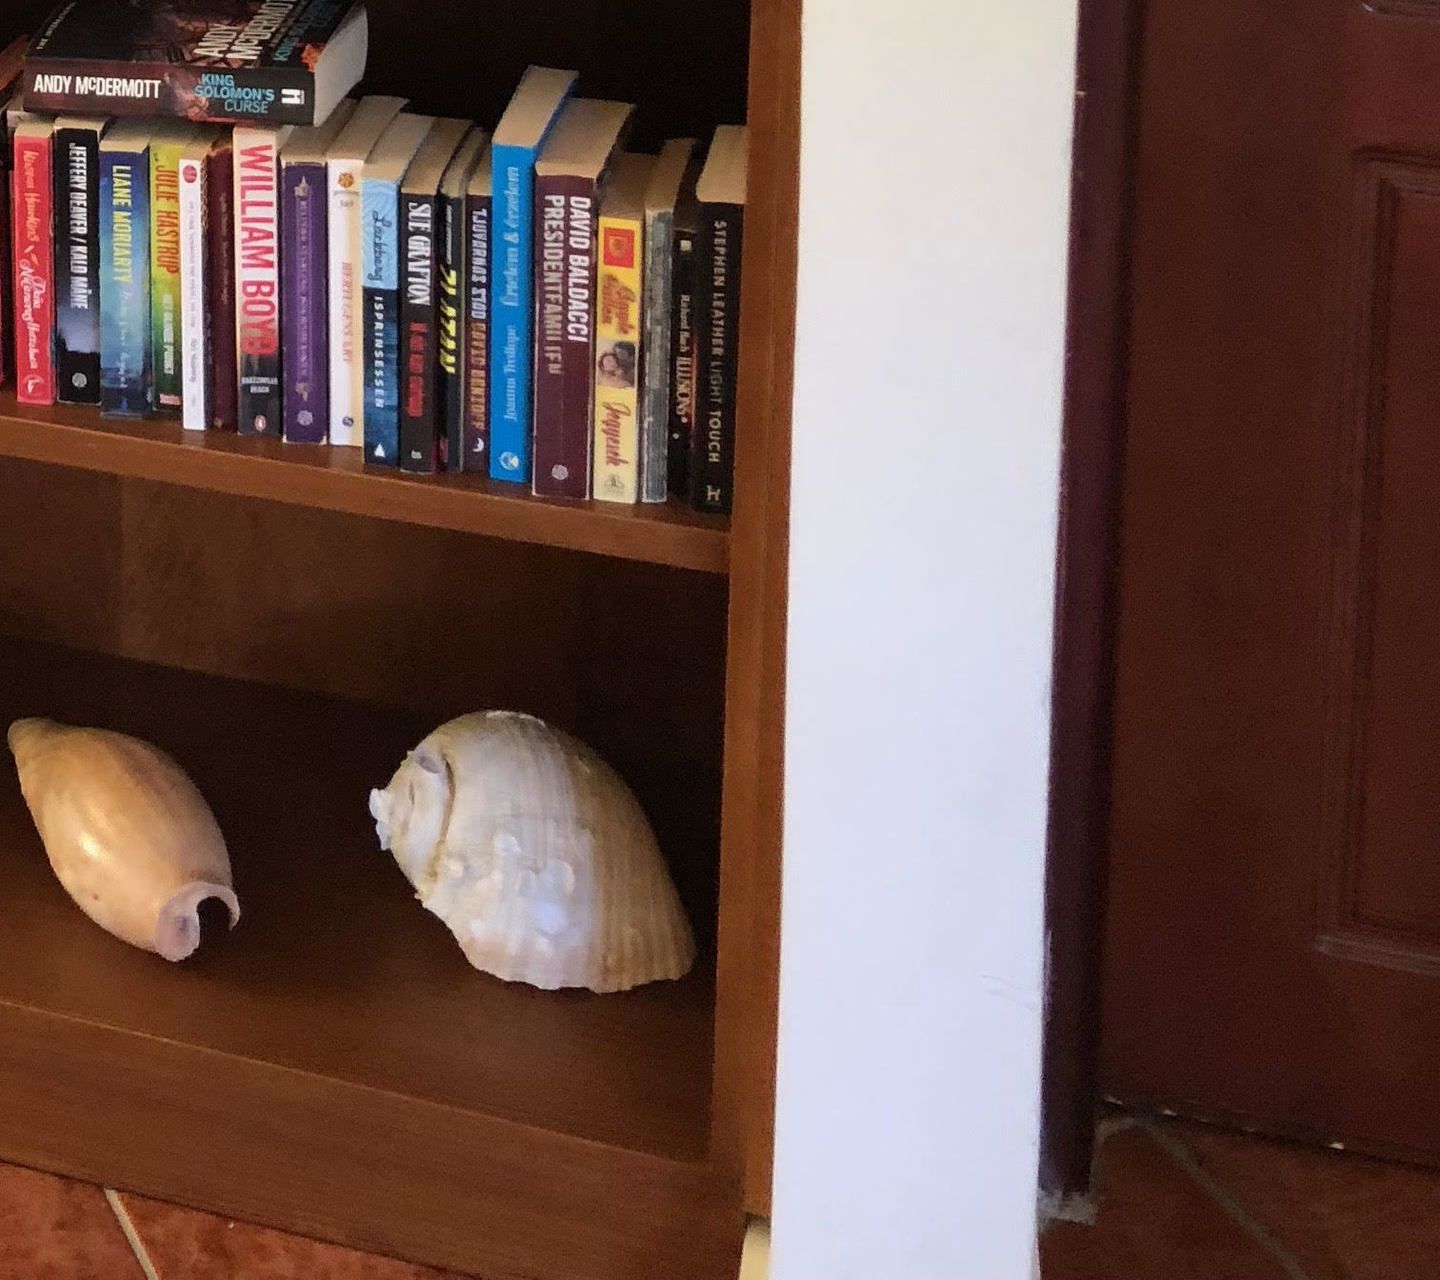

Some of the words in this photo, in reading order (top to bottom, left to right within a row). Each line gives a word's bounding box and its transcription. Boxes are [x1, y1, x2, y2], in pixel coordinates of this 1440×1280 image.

[192, 23, 237, 58] ANDY
[33, 74, 72, 94] ANDY
[75, 76, 161, 99] McDERMOTT
[194, 85, 275, 101] SOLOMON'S
[201, 73, 234, 86] KING
[224, 98, 269, 114] CURSE
[68, 143, 87, 189] JEFFERY
[112, 165, 132, 206] LIANE
[155, 165, 178, 202] JULIE
[69, 192, 88, 235] DEAVER
[238, 145, 275, 270] WILLIAM
[408, 202, 431, 232] SUE
[568, 196, 590, 246] DAVID
[71, 246, 89, 274] KALD
[112, 211, 133, 283] MORIARTY
[155, 210, 179, 274] HASTRUP
[367, 211, 389, 281] Läckberg
[713, 220, 727, 286] STEPHEN
[71, 277, 93, 309] MÅNE
[407, 235, 432, 307] GRAFTON
[241, 280, 277, 356] BOYD
[566, 254, 589, 342] BALDACCI
[681, 295, 690, 329] Richard
[680, 331, 689, 352] Bach
[711, 292, 726, 358] LEATHER
[373, 296, 384, 409] ISPRINSESSEN
[676, 356, 691, 418] ILLUSIONS
[710, 361, 723, 403] LIGHT
[708, 411, 722, 463] TOUCH
